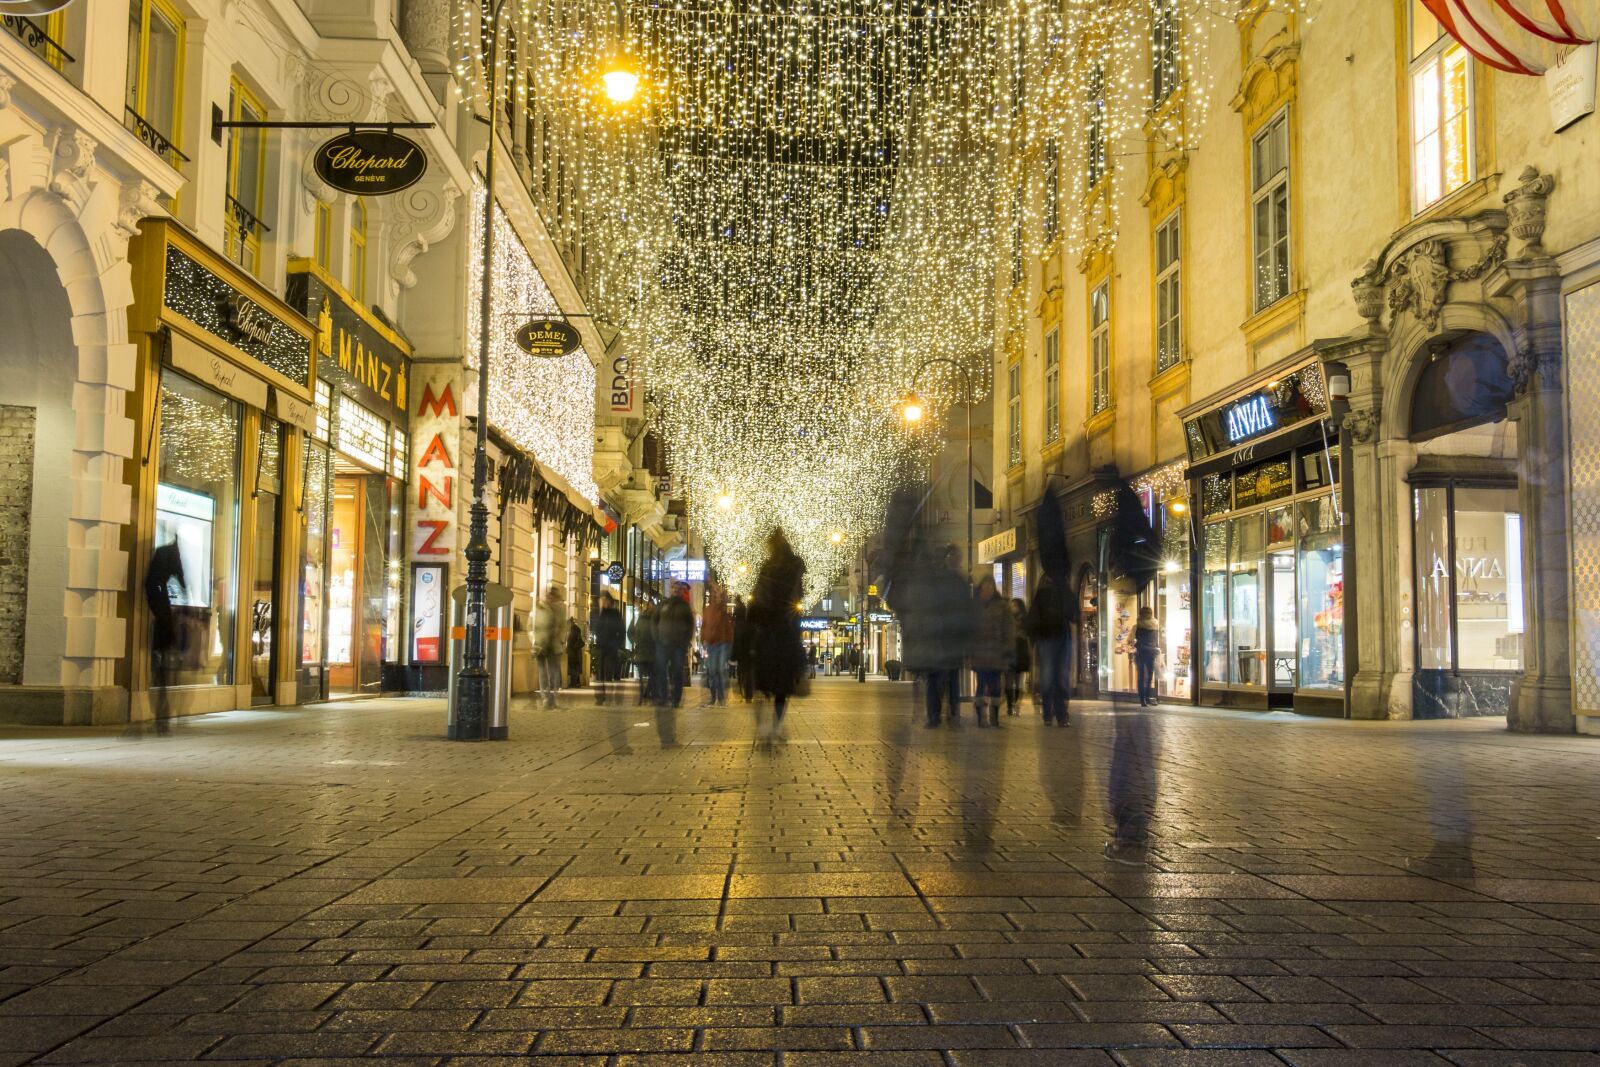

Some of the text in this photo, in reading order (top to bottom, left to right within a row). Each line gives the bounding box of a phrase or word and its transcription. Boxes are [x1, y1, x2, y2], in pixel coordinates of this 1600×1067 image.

[326, 145, 414, 173] Chopard
[236, 294, 275, 345] Chopard
[528, 331, 568, 342] DEMEL
[339, 328, 391, 401] MANZ
[611, 356, 630, 406] BDO
[1228, 395, 1273, 441] ANNA
[417, 382, 458, 555] MANZ
[1430, 557, 1506, 579] ANNA
